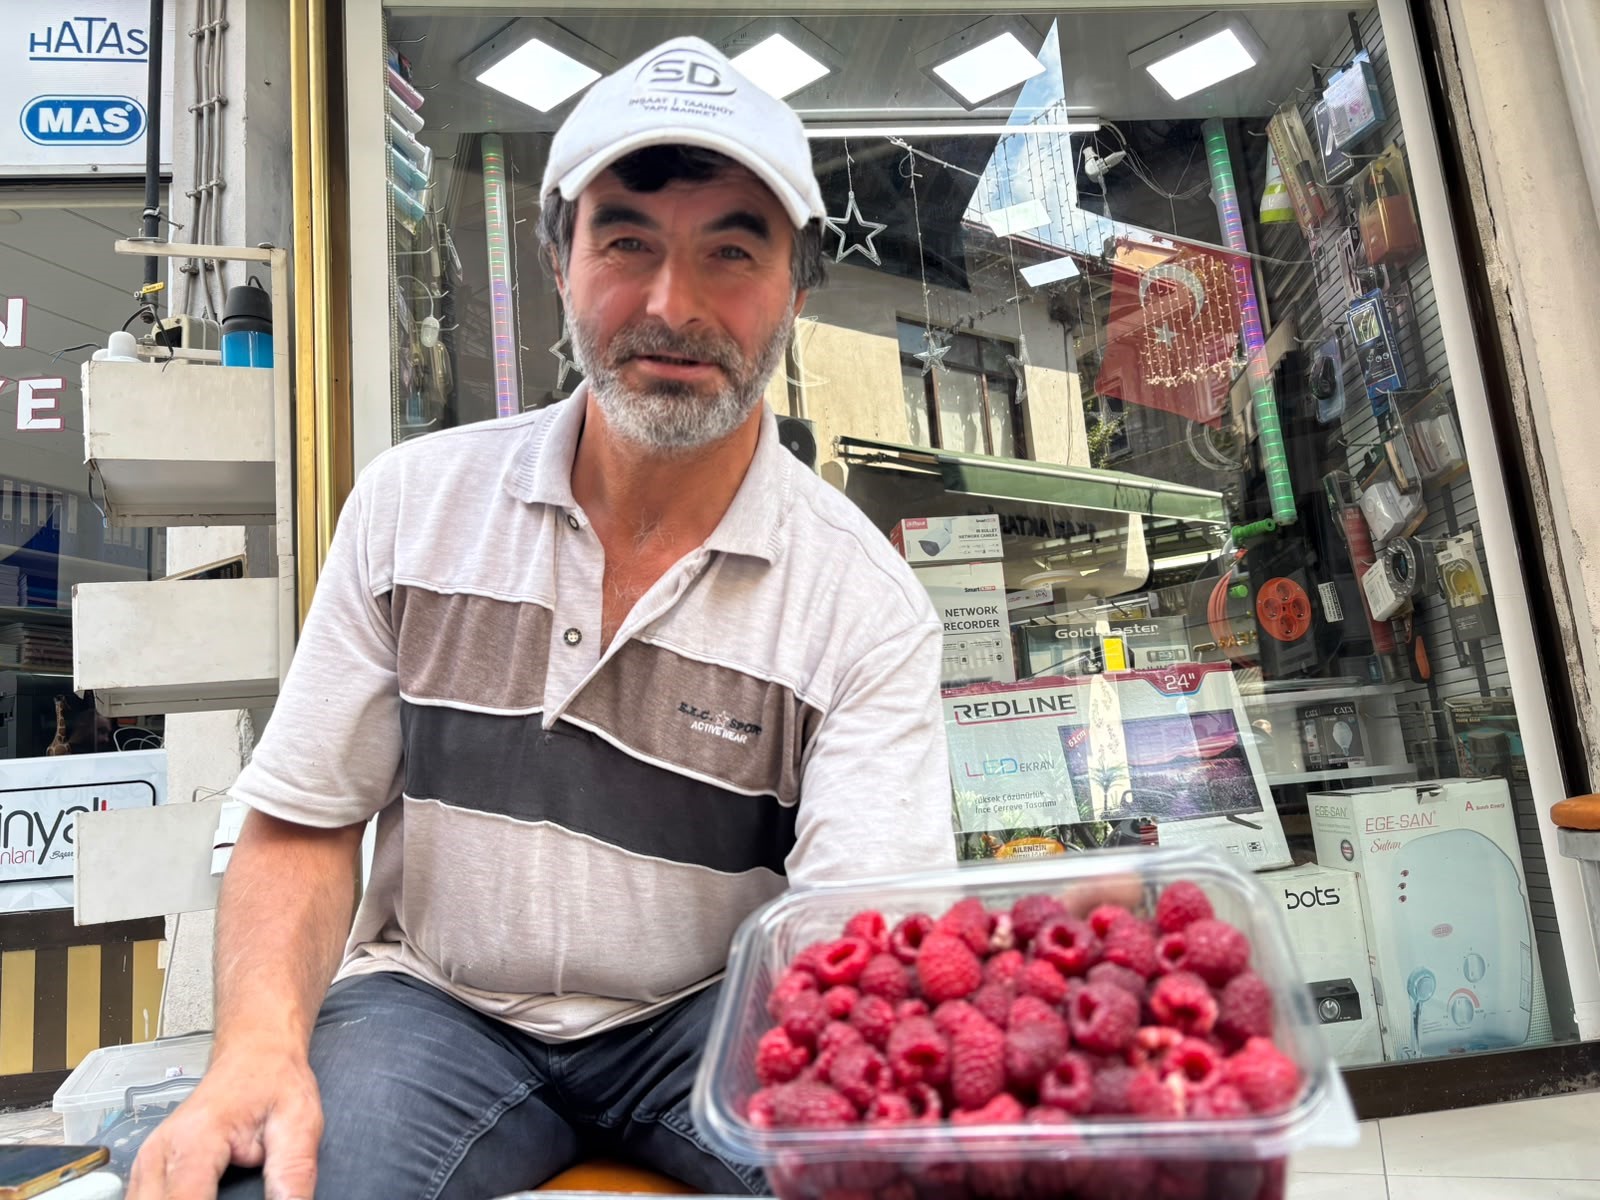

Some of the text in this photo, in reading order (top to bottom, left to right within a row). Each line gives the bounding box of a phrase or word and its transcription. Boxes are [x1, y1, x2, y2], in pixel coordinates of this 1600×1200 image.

[649, 60, 721, 87] SD
[38, 106, 131, 134] MAS
[945, 605, 999, 618] NETWORK
[943, 619, 1000, 632] RECORDER
[1055, 623, 1159, 639] Goldaster
[953, 693, 1077, 719] REDLINE
[1019, 759, 1055, 773] EKRAN
[1365, 811, 1434, 832] EGE-SAN
[1370, 838, 1402, 853] Sultan
[1284, 885, 1340, 910] bots
